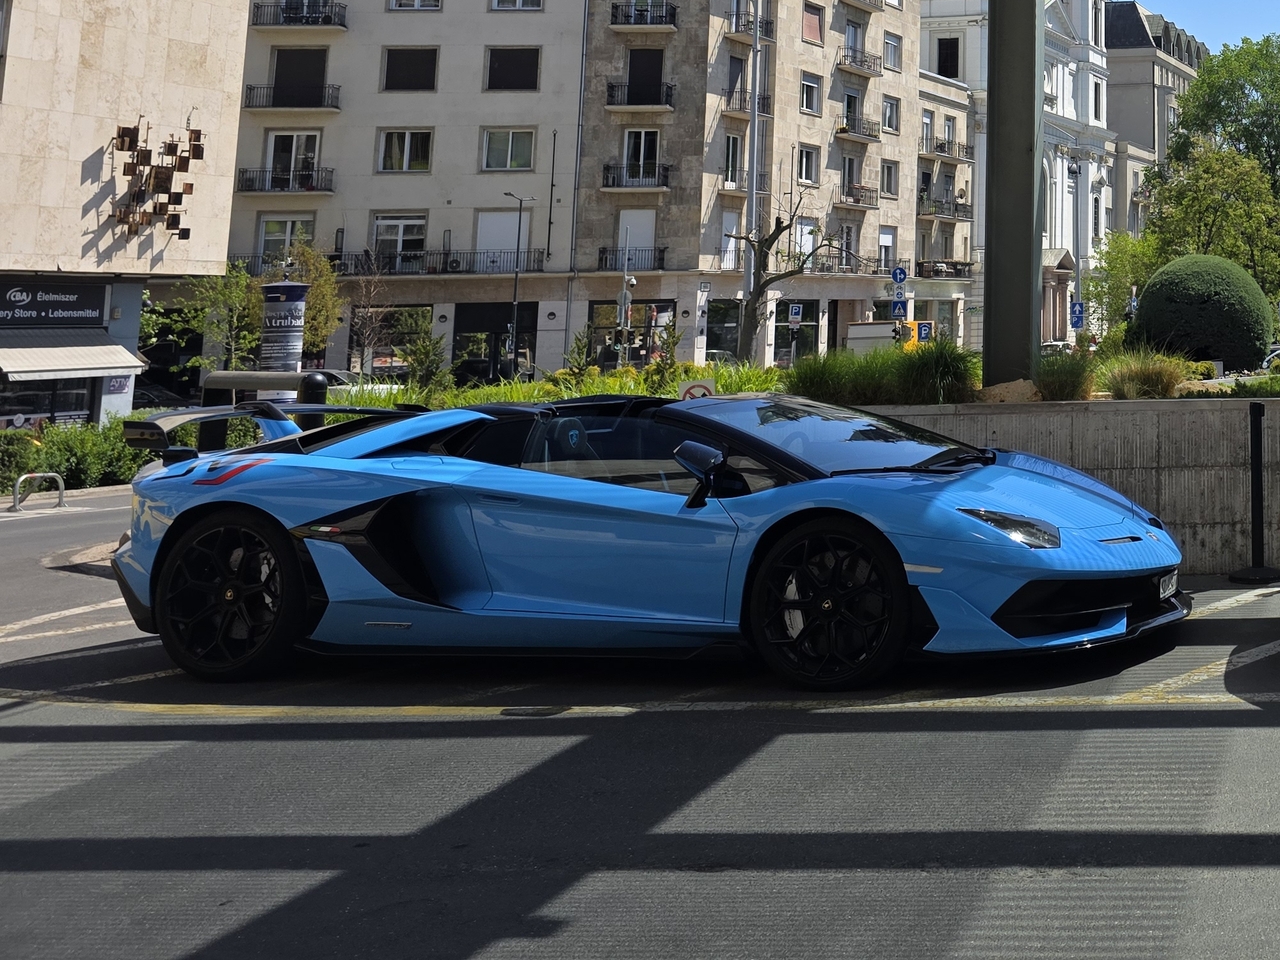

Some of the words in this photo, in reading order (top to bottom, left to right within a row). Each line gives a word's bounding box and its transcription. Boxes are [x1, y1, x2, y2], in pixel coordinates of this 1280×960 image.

[10, 291, 28, 301] CBA
[37, 291, 78, 301] Élelmiszer
[14, 309, 37, 318] Store
[49, 309, 99, 318] Lebensmittel
[792, 306, 799, 316] P
[110, 378, 129, 387] ATM
